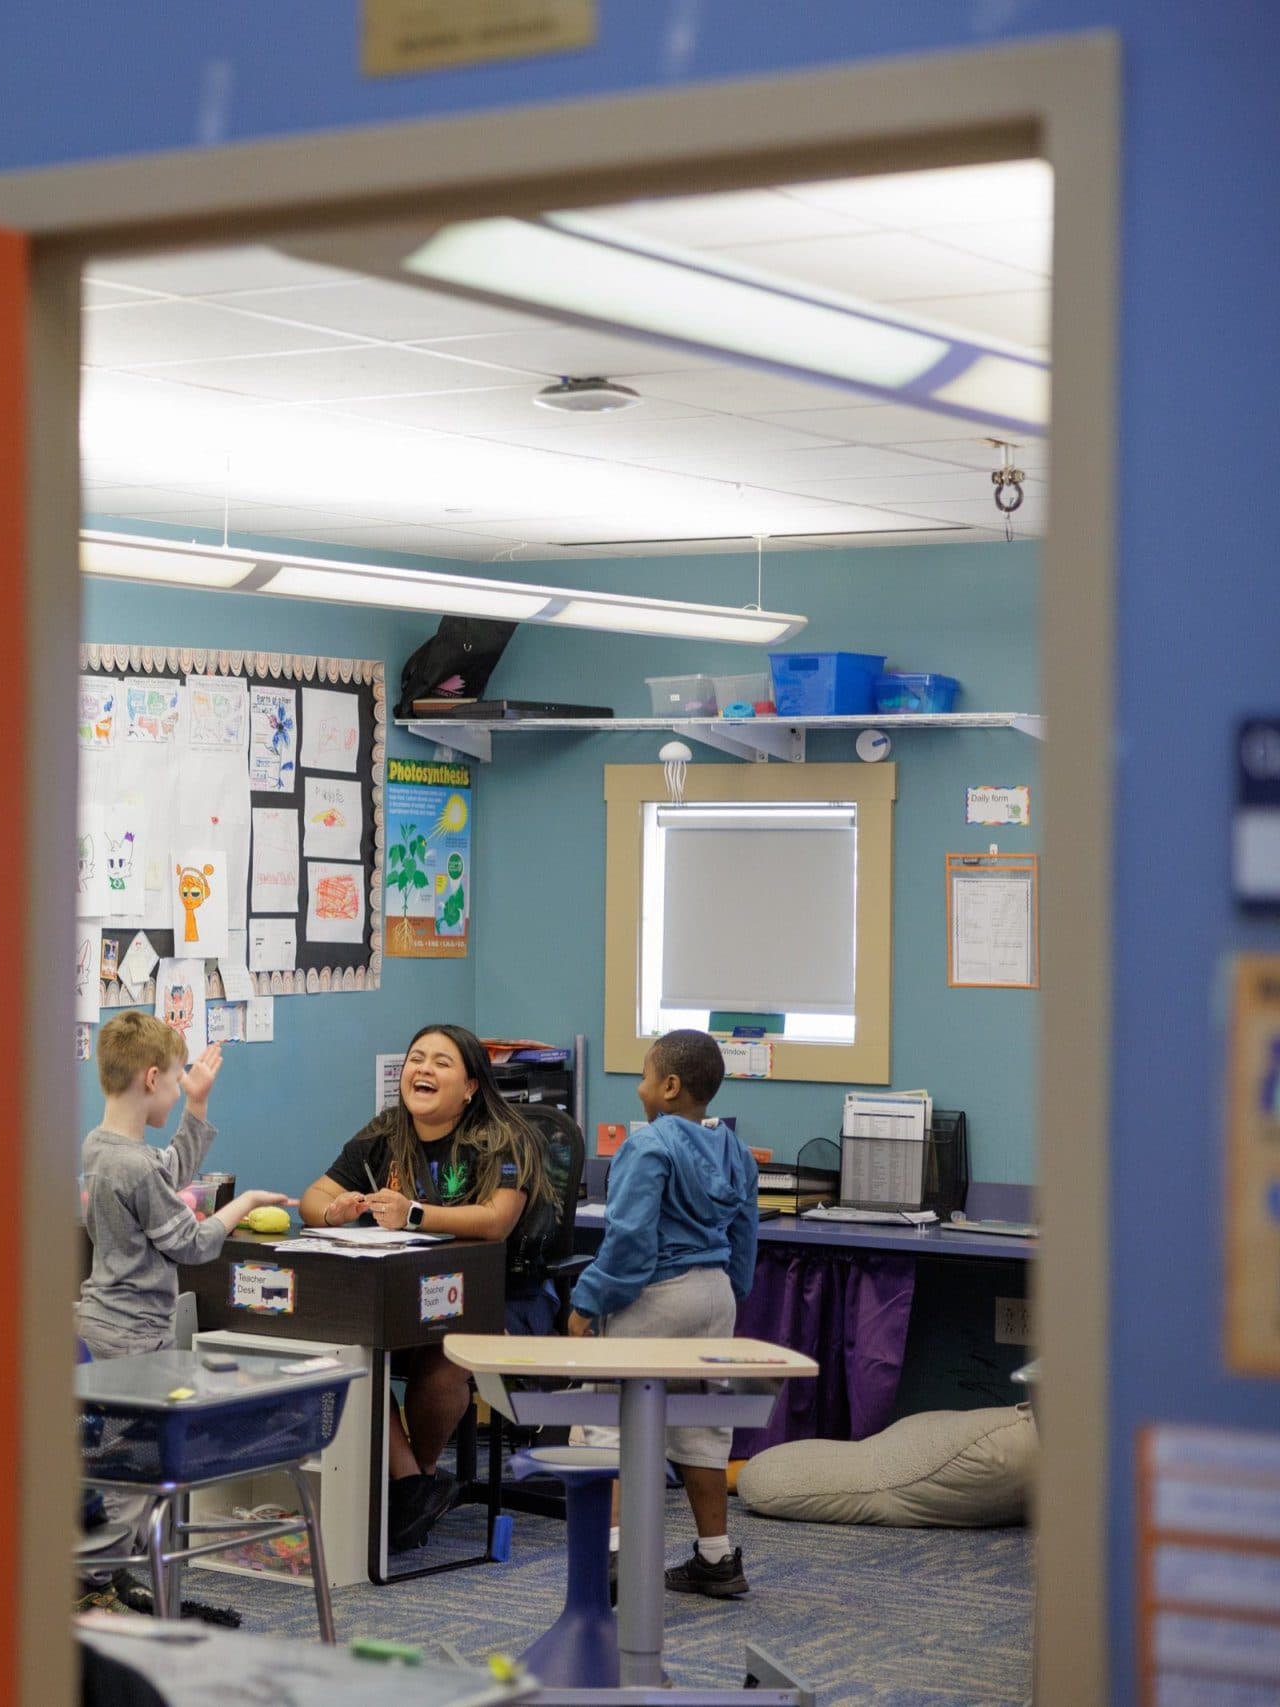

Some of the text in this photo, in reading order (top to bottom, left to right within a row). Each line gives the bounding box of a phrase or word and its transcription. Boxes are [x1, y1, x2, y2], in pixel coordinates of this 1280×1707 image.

[389, 761, 470, 785] Photosynthesis
[971, 793, 1009, 803] Daily form
[239, 1273, 267, 1283] Teacher
[238, 1285, 255, 1294] Desk
